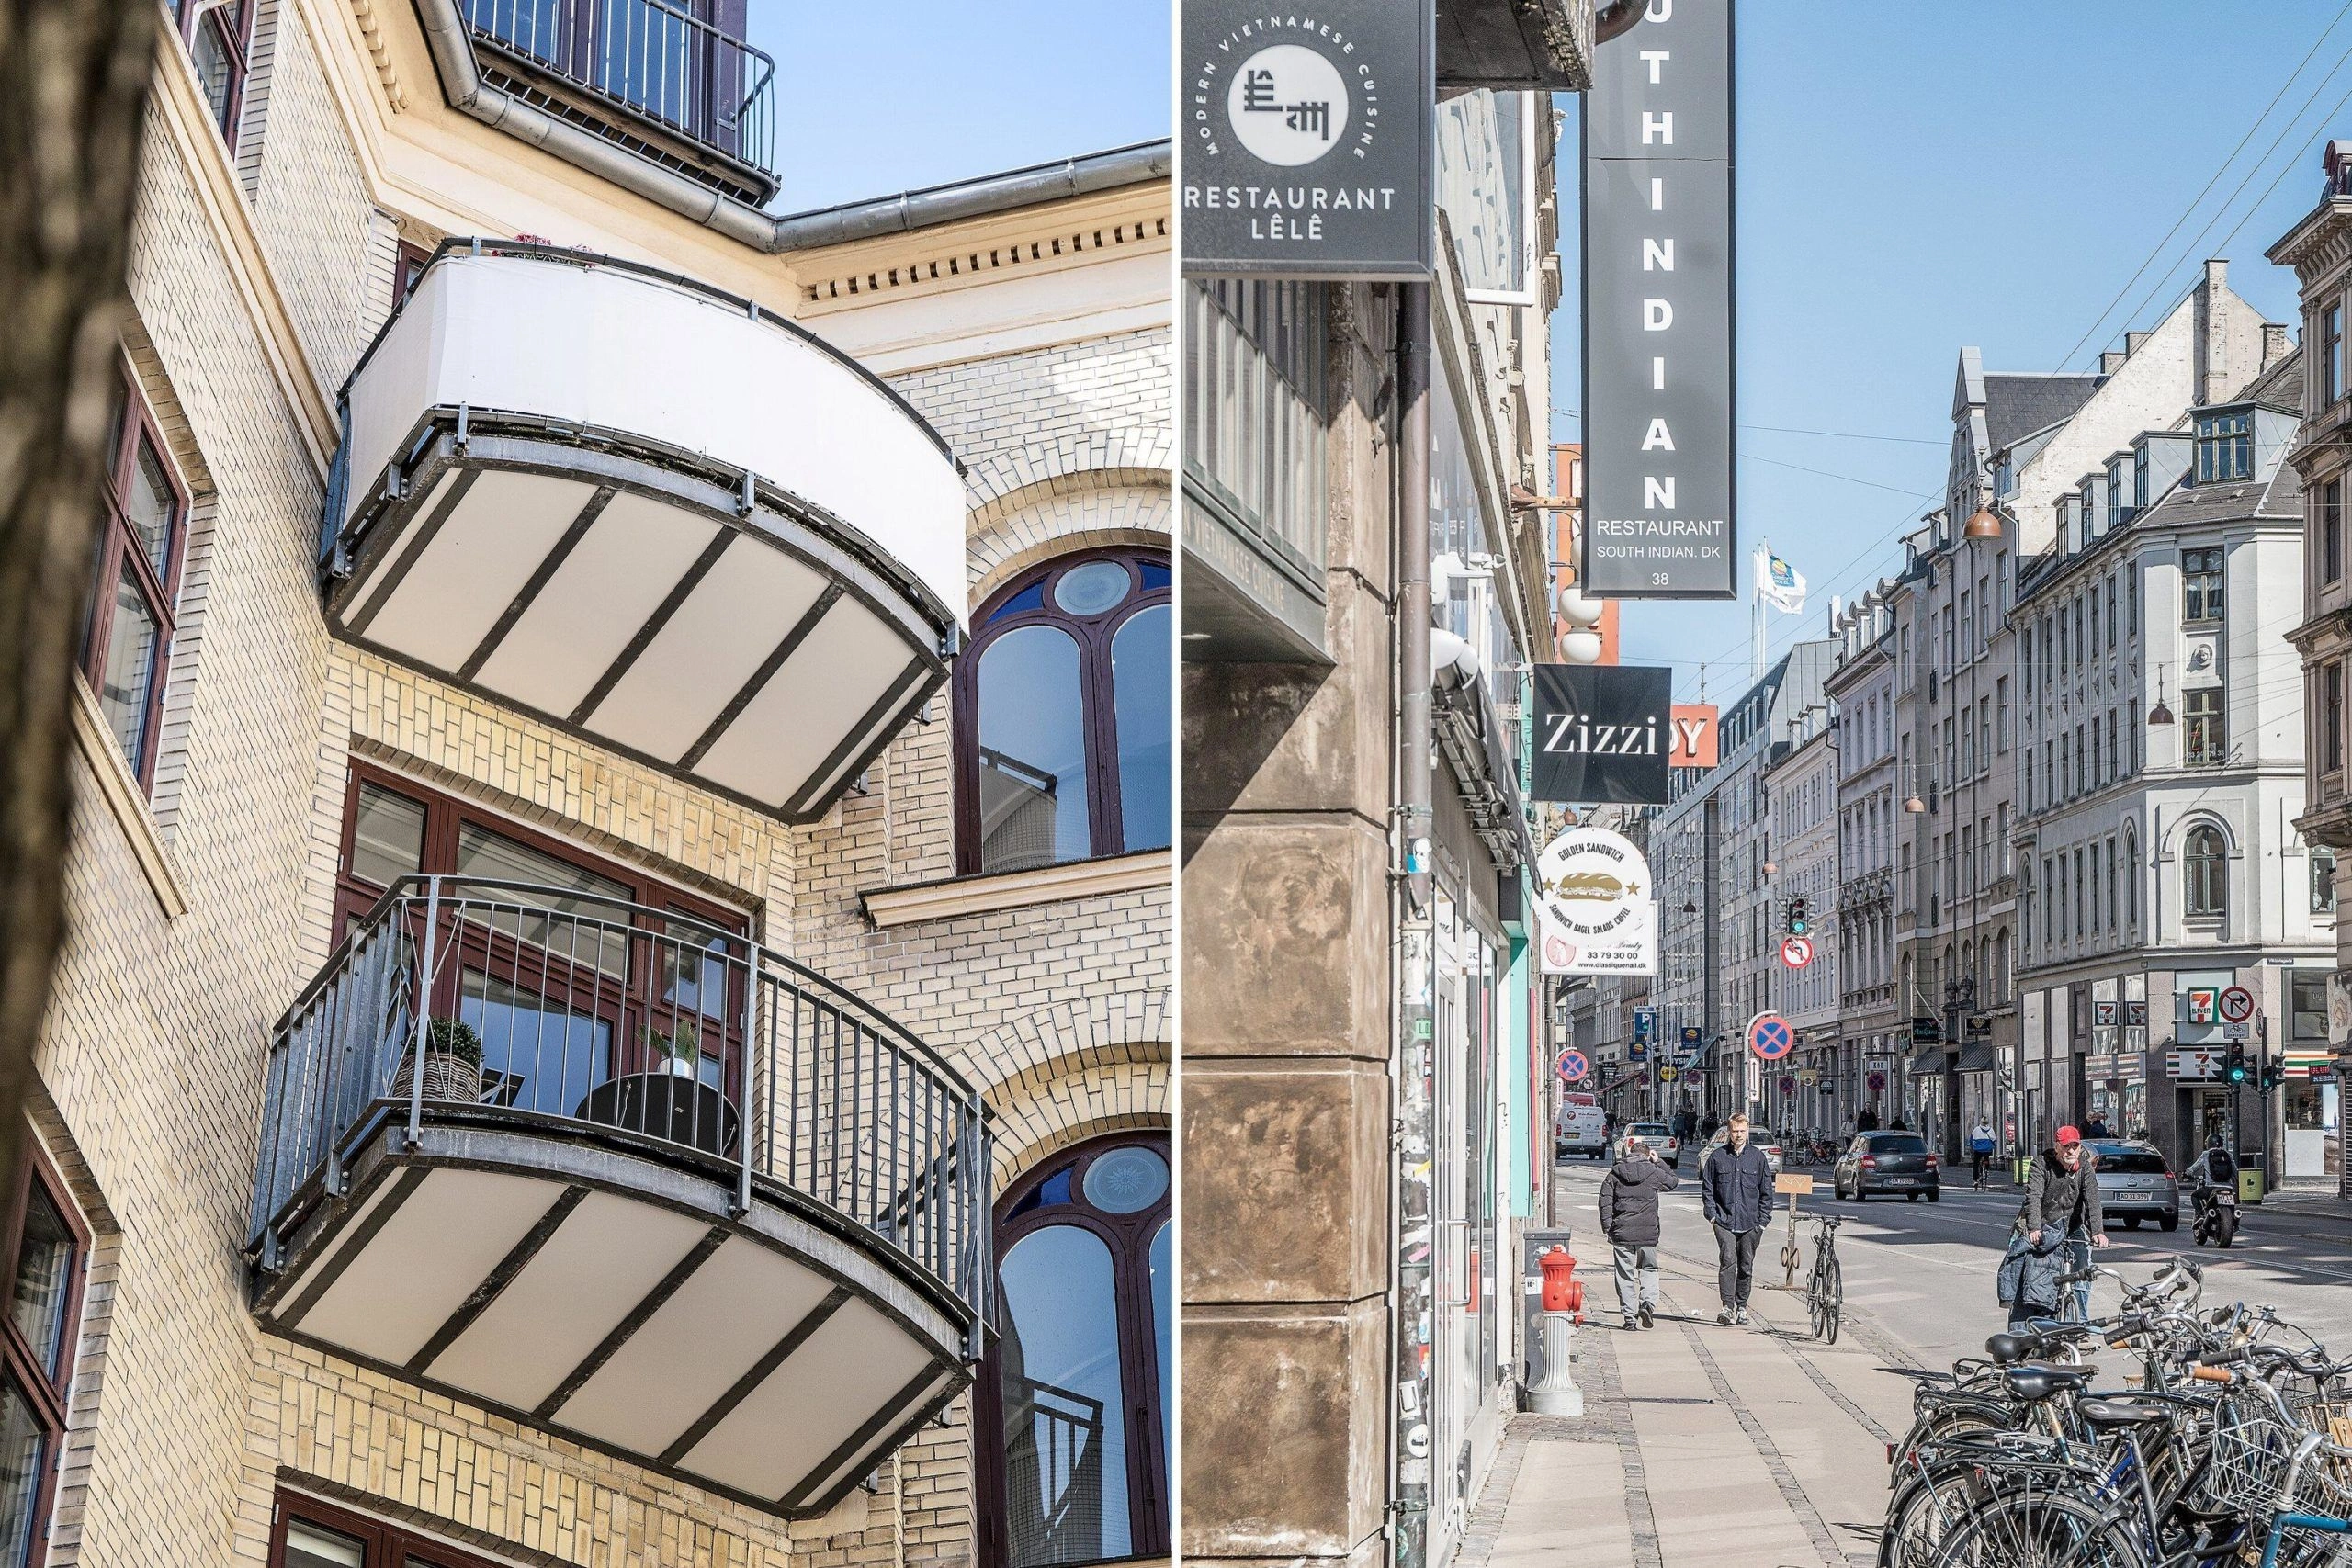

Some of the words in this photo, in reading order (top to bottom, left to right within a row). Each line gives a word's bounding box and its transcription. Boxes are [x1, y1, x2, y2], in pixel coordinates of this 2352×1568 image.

[1196, 62, 1219, 155] MODERN
[1219, 15, 1354, 54] VIETNAMESE
[1353, 64, 1378, 160] CUISINE
[1184, 186, 1395, 210] RESTAURANT
[1251, 213, 1323, 240] LÊLÊ
[1596, 520, 1724, 536] RESTAURANT
[1597, 546, 1644, 558] SOUTH
[1702, 546, 1721, 558] DK
[1651, 572, 1669, 586] 38
[1543, 714, 1658, 756] Zizzi
[1557, 843, 1585, 862] GOLDEN
[1587, 842, 1625, 863] SANDWICH
[1549, 903, 1573, 929] SANDWICH
[1573, 922, 1590, 935] BAGEL
[1593, 920, 1614, 935] SALADS
[1613, 907, 1631, 925] COFFEE
[1577, 962, 1647, 970] www.classiquenail.dk
[1587, 952, 1599, 960] 33
[1600, 952, 1611, 960] 79
[1613, 952, 1625, 960] 30
[1626, 952, 1638, 960] 00
[2190, 993, 2211, 1023] 7
